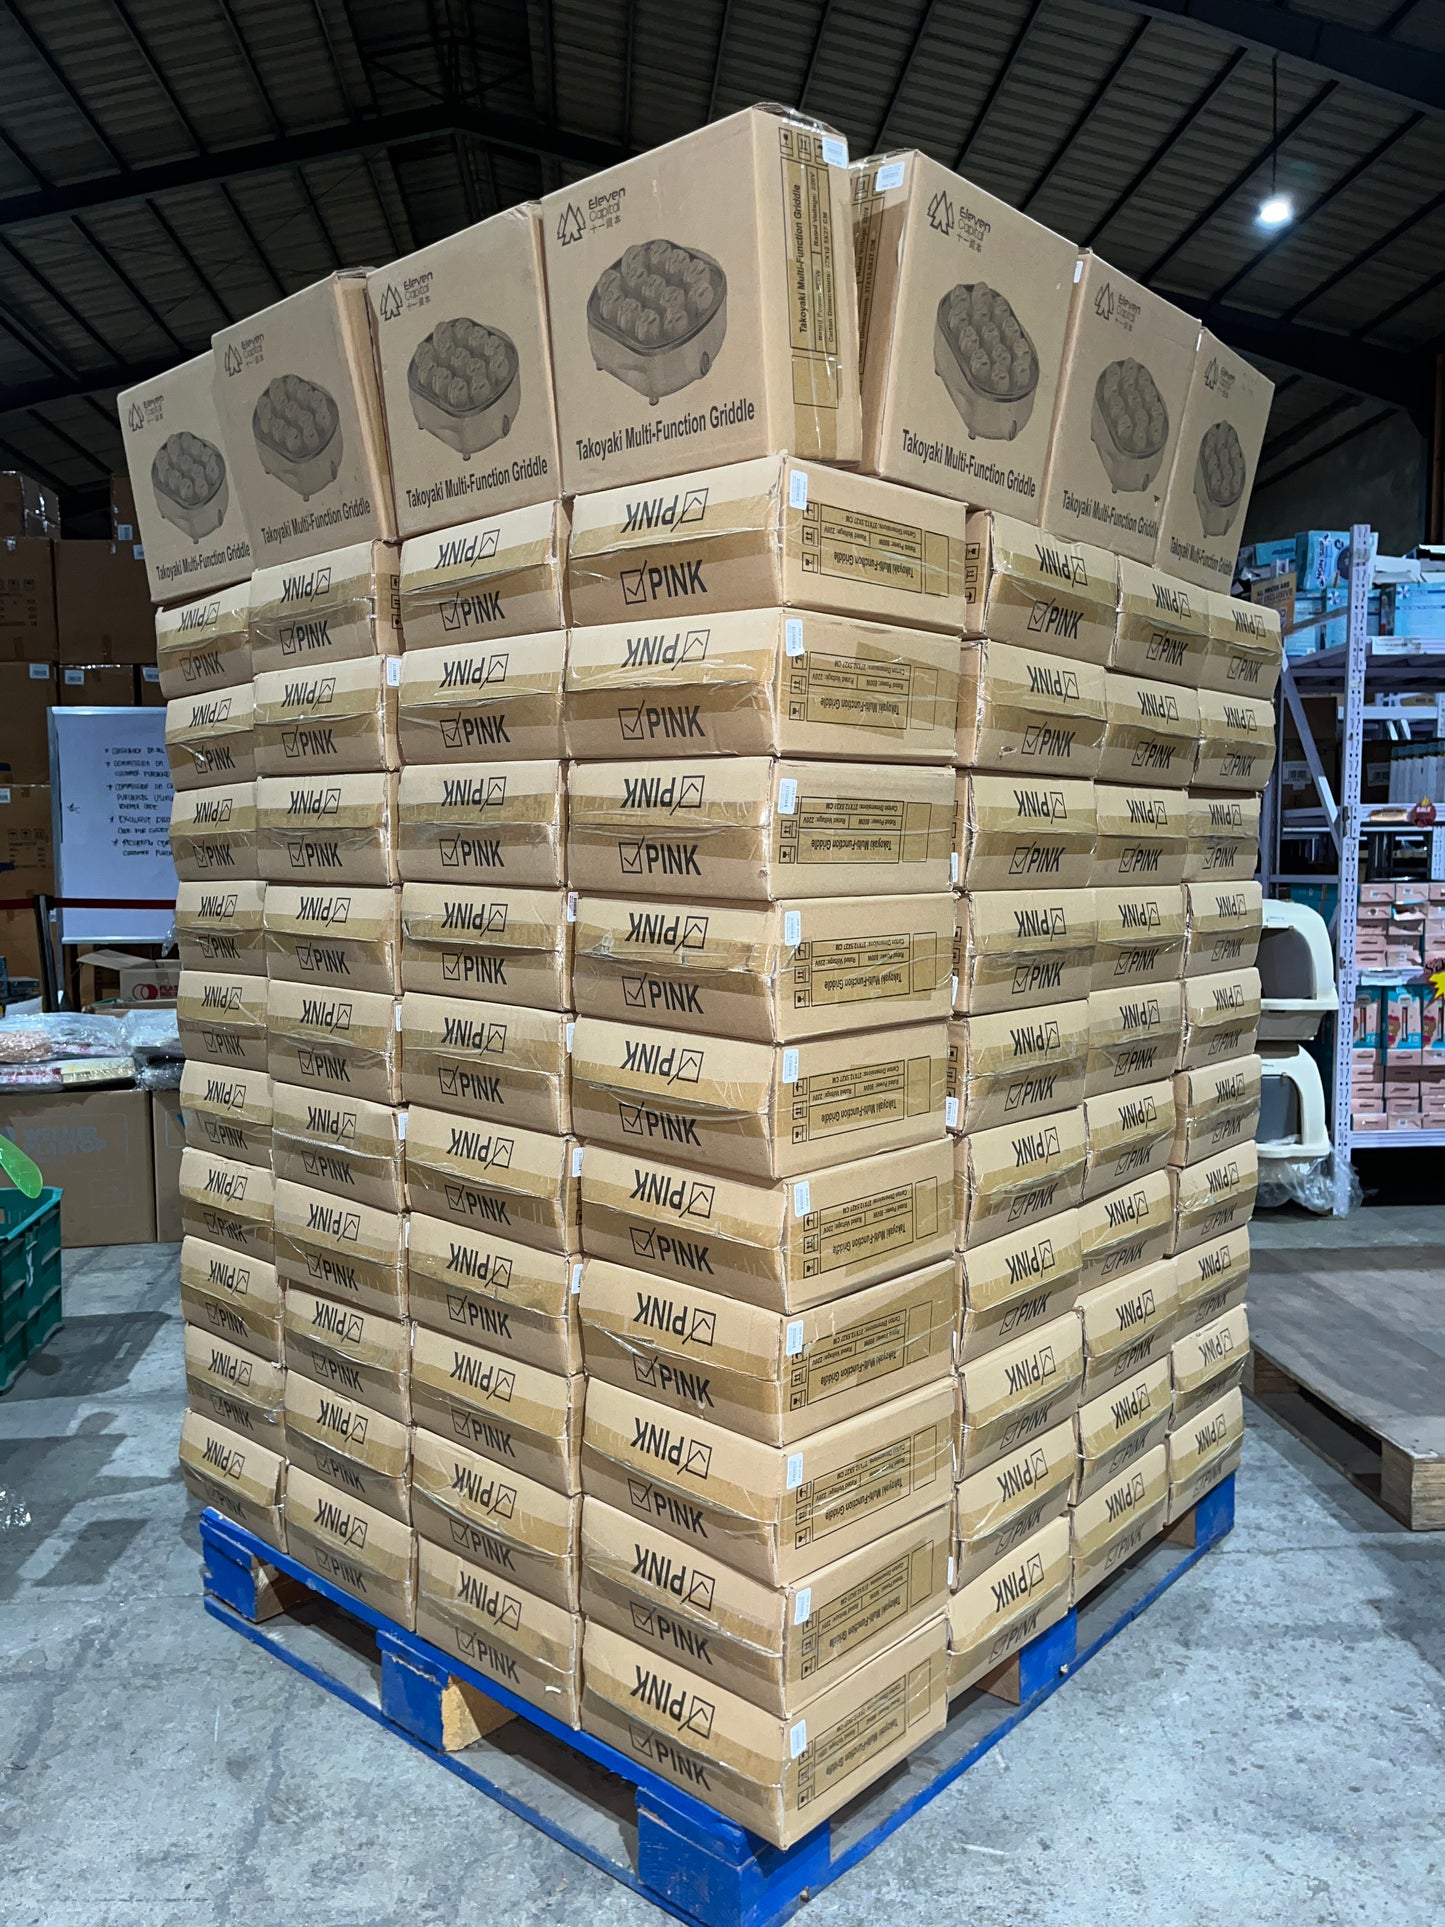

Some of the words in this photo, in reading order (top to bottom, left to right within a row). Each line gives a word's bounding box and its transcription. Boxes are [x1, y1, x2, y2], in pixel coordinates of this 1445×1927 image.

[589, 188, 625, 210] Eleven
[589, 200, 620, 222] Capital
[793, 185, 802, 219] Griddle
[822, 212, 828, 224] CM
[959, 219, 985, 242] Capital
[960, 206, 991, 234] Eleven
[796, 223, 806, 290] Multi-Function
[404, 272, 433, 290] Eleven
[799, 293, 808, 333] Takoyaki
[1118, 294, 1141, 315] Eleven
[241, 334, 264, 349] Eleven
[576, 430, 622, 461] Takoyaki
[626, 413, 706, 449] Multi-Function
[710, 398, 755, 428] Griddle
[903, 429, 943, 463] Takoyaki
[944, 445, 1005, 486] Multi-Function
[1007, 470, 1035, 497] Griddle
[406, 483, 444, 508] Takoyaki
[445, 467, 510, 499] Multi-Function
[512, 456, 548, 481] Griddle
[261, 521, 291, 544] Takoyaki
[291, 510, 343, 536] Multi-Function
[343, 497, 370, 520] Griddle
[1062, 490, 1092, 518] Takoyaki
[1092, 503, 1137, 534] Multi-Function
[156, 560, 182, 581] Takoyaki
[182, 550, 226, 572] Multi-Function
[226, 541, 250, 561] Griddle
[434, 536, 476, 569] PINK
[834, 551, 854, 565] Griddle
[855, 556, 891, 574] Multi-Function
[1035, 544, 1072, 579] PINK
[1170, 537, 1190, 560] Takoyaki
[1190, 545, 1219, 572] Multi-Function
[650, 560, 707, 599] PINK
[891, 563, 914, 577] Takoyaki
[178, 610, 206, 632] PINK
[297, 620, 332, 645] PINK
[1232, 610, 1256, 634] PINK
[621, 634, 680, 667] PINK
[1159, 636, 1188, 666] PINK
[281, 681, 317, 707] PINK
[821, 697, 841, 708] Griddle
[842, 700, 877, 713] Multi-Function
[1137, 692, 1166, 719] PINK
[878, 703, 899, 715] Takoyaki
[465, 715, 510, 744] PINK
[1040, 729, 1076, 757] PINK
[206, 746, 236, 770] PINK
[1230, 754, 1255, 776] PINK
[441, 777, 484, 806] PINK
[1013, 790, 1049, 817] PINK
[193, 800, 219, 823] PINK
[804, 816, 814, 824] 220V
[1209, 805, 1231, 825] PINK
[306, 842, 342, 867] PINK
[811, 839, 831, 851] Griddle
[832, 839, 869, 850] Multi-Function
[870, 838, 892, 851] Takoyaki
[647, 843, 702, 875] PINK
[1132, 849, 1163, 871] PINK
[296, 897, 333, 920] PINK
[1118, 904, 1147, 927] PINK
[625, 913, 679, 944] PINK
[212, 937, 240, 958] PINK
[1222, 938, 1244, 959] PINK
[465, 956, 507, 985] PINK
[845, 975, 880, 988] Multi-Function
[881, 972, 902, 984] Takoyaki
[1028, 962, 1066, 989] PINK
[201, 986, 228, 1008] PINK
[824, 979, 843, 991] Griddle
[1212, 989, 1235, 1010] PINK
[441, 1018, 485, 1048] PINK
[1010, 1029, 1045, 1055] PINK
[315, 1050, 350, 1081] PINK
[1128, 1047, 1157, 1072] PINK
[1215, 1079, 1237, 1102] PINK
[822, 1111, 840, 1124] Griddle
[841, 1104, 875, 1119] Multi-Function
[876, 1099, 896, 1112] Takoyaki
[1118, 1105, 1145, 1130] PINK
[306, 1107, 340, 1135] PINK
[647, 1103, 701, 1146] PINK
[220, 1124, 248, 1149] PINK
[205, 1169, 235, 1193] PINK
[629, 1169, 687, 1209] PINK
[1206, 1167, 1229, 1193] PINK
[466, 1192, 511, 1226] PINK
[1024, 1183, 1059, 1214] PINK
[446, 1243, 489, 1278] PINK
[1005, 1249, 1039, 1284] PINK
[1115, 1241, 1148, 1271] PINK
[1198, 1253, 1222, 1281] PINK
[208, 1260, 235, 1286] PINK
[323, 1260, 359, 1291] PINK
[312, 1302, 347, 1335] PINK
[1116, 1299, 1144, 1331] PINK
[208, 1350, 237, 1377] PINK
[1198, 1338, 1222, 1367] PINK
[660, 1363, 714, 1407] PINK
[1005, 1358, 1040, 1395] PINK
[1111, 1395, 1138, 1429] PINK
[472, 1416, 516, 1458] PINK
[630, 1417, 684, 1464] PINK
[1195, 1425, 1217, 1455] PINK
[329, 1456, 365, 1492] PINK
[452, 1464, 494, 1500] PINK
[996, 1462, 1031, 1502] PINK
[313, 1498, 350, 1537] PINK
[1105, 1485, 1134, 1523] PINK
[991, 1565, 1027, 1612] PINK
[659, 1614, 712, 1664] PINK
[479, 1644, 520, 1683] PINK
[630, 1665, 687, 1722] PINK
